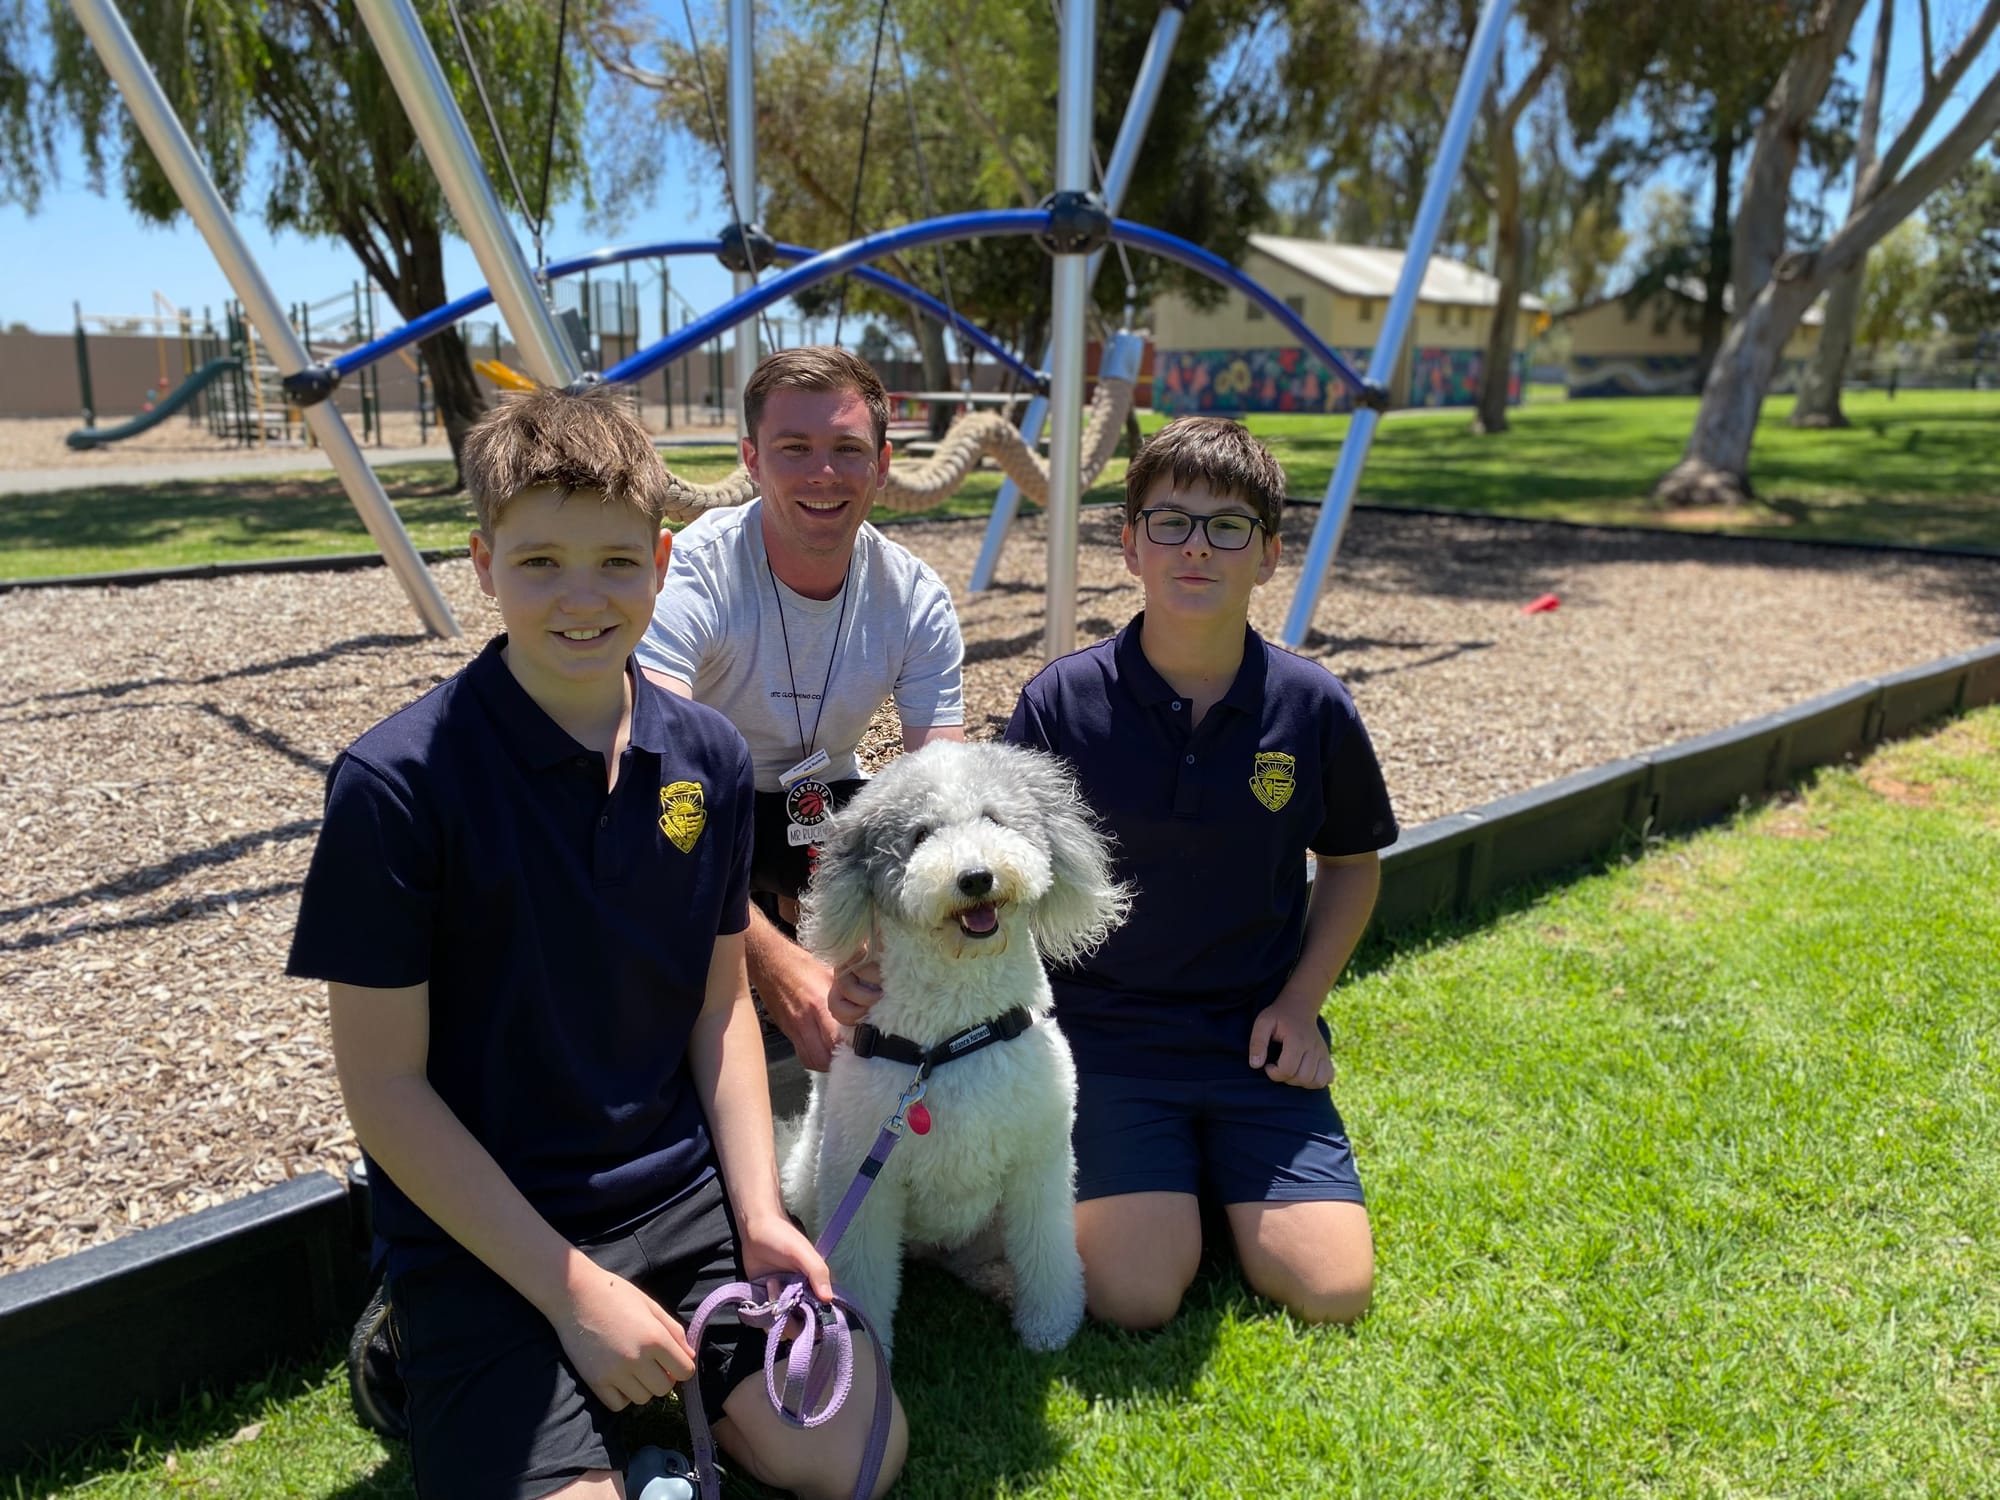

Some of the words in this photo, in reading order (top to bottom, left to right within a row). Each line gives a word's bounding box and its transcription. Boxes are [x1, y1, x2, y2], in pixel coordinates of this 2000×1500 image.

[782, 691, 810, 700] CLOHING
[790, 783, 829, 803] TORONTO
[793, 810, 828, 825] RAPTOR
